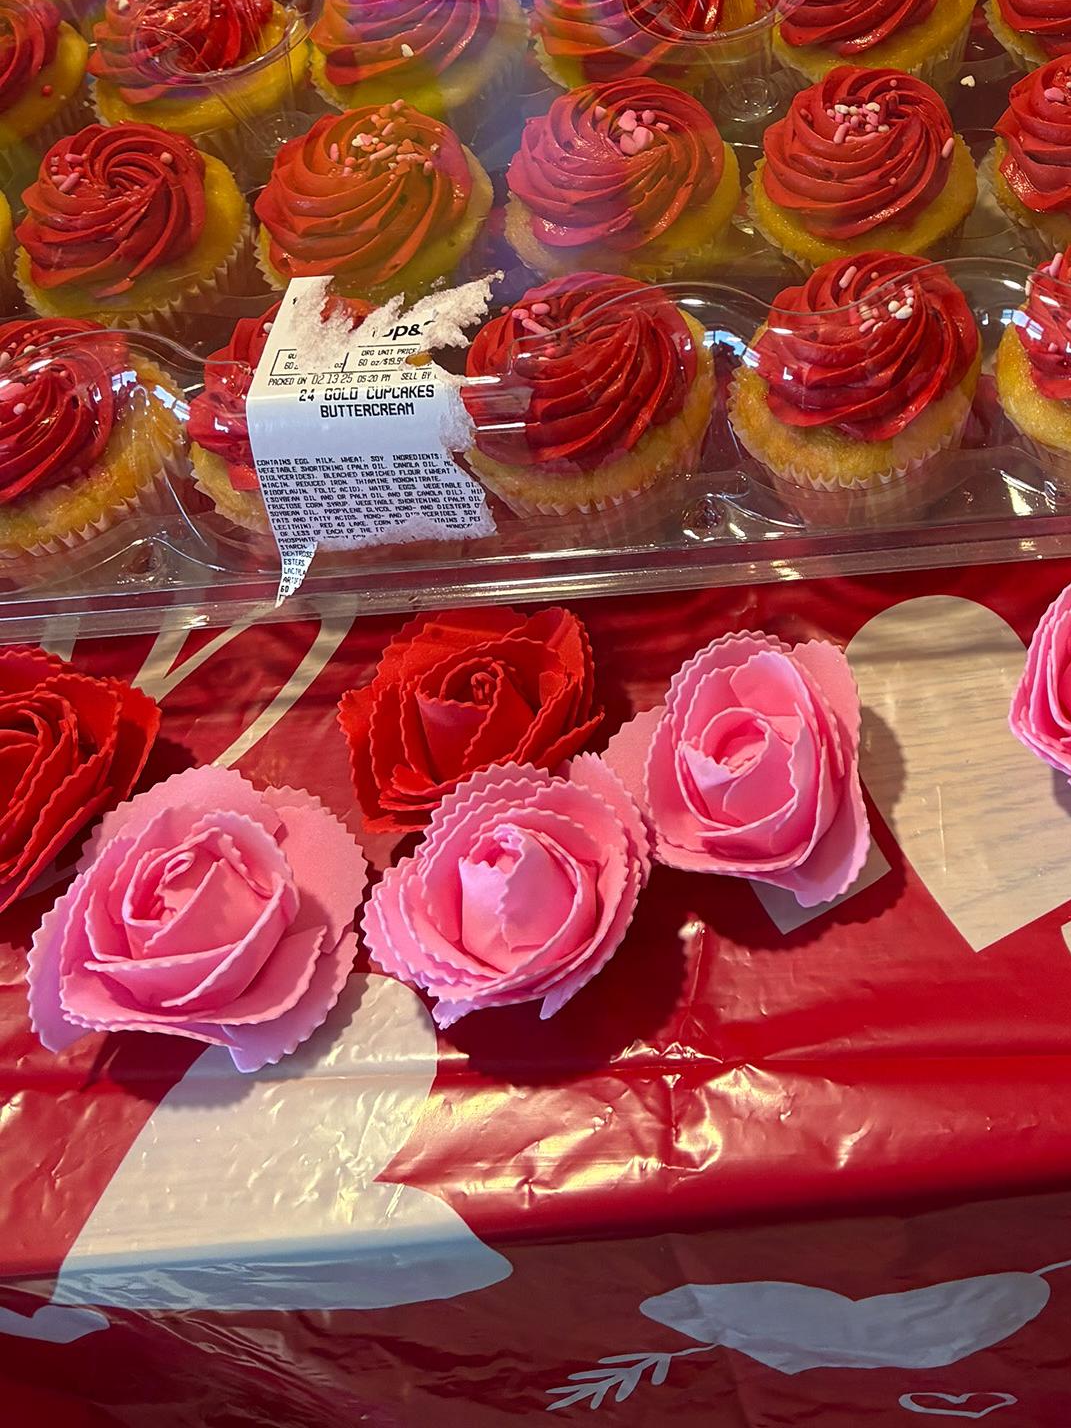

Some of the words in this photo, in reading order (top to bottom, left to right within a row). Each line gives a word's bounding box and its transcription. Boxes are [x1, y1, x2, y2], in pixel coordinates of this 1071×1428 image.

[268, 376, 295, 386] PACKED
[296, 376, 308, 385] ON
[380, 373, 391, 381] PM
[400, 371, 417, 381] SELL
[421, 371, 432, 380] BY
[299, 388, 315, 402] 24
[324, 387, 359, 401] GOLD
[366, 384, 435, 400] CUPCAKES
[320, 401, 415, 418] BUTTERCREAM
[256, 458, 291, 466] CONTAINS
[392, 453, 442, 461] INGREDIENTS:
[257, 466, 297, 474] VEGETABLE
[300, 464, 344, 473] SHORTENING
[347, 463, 369, 471] (PALM
[323, 471, 358, 479] BLEACHED
[416, 489, 443, 497] CANOLA
[267, 502, 302, 510] FRUCTOSE
[397, 497, 441, 505] SHORTENING
